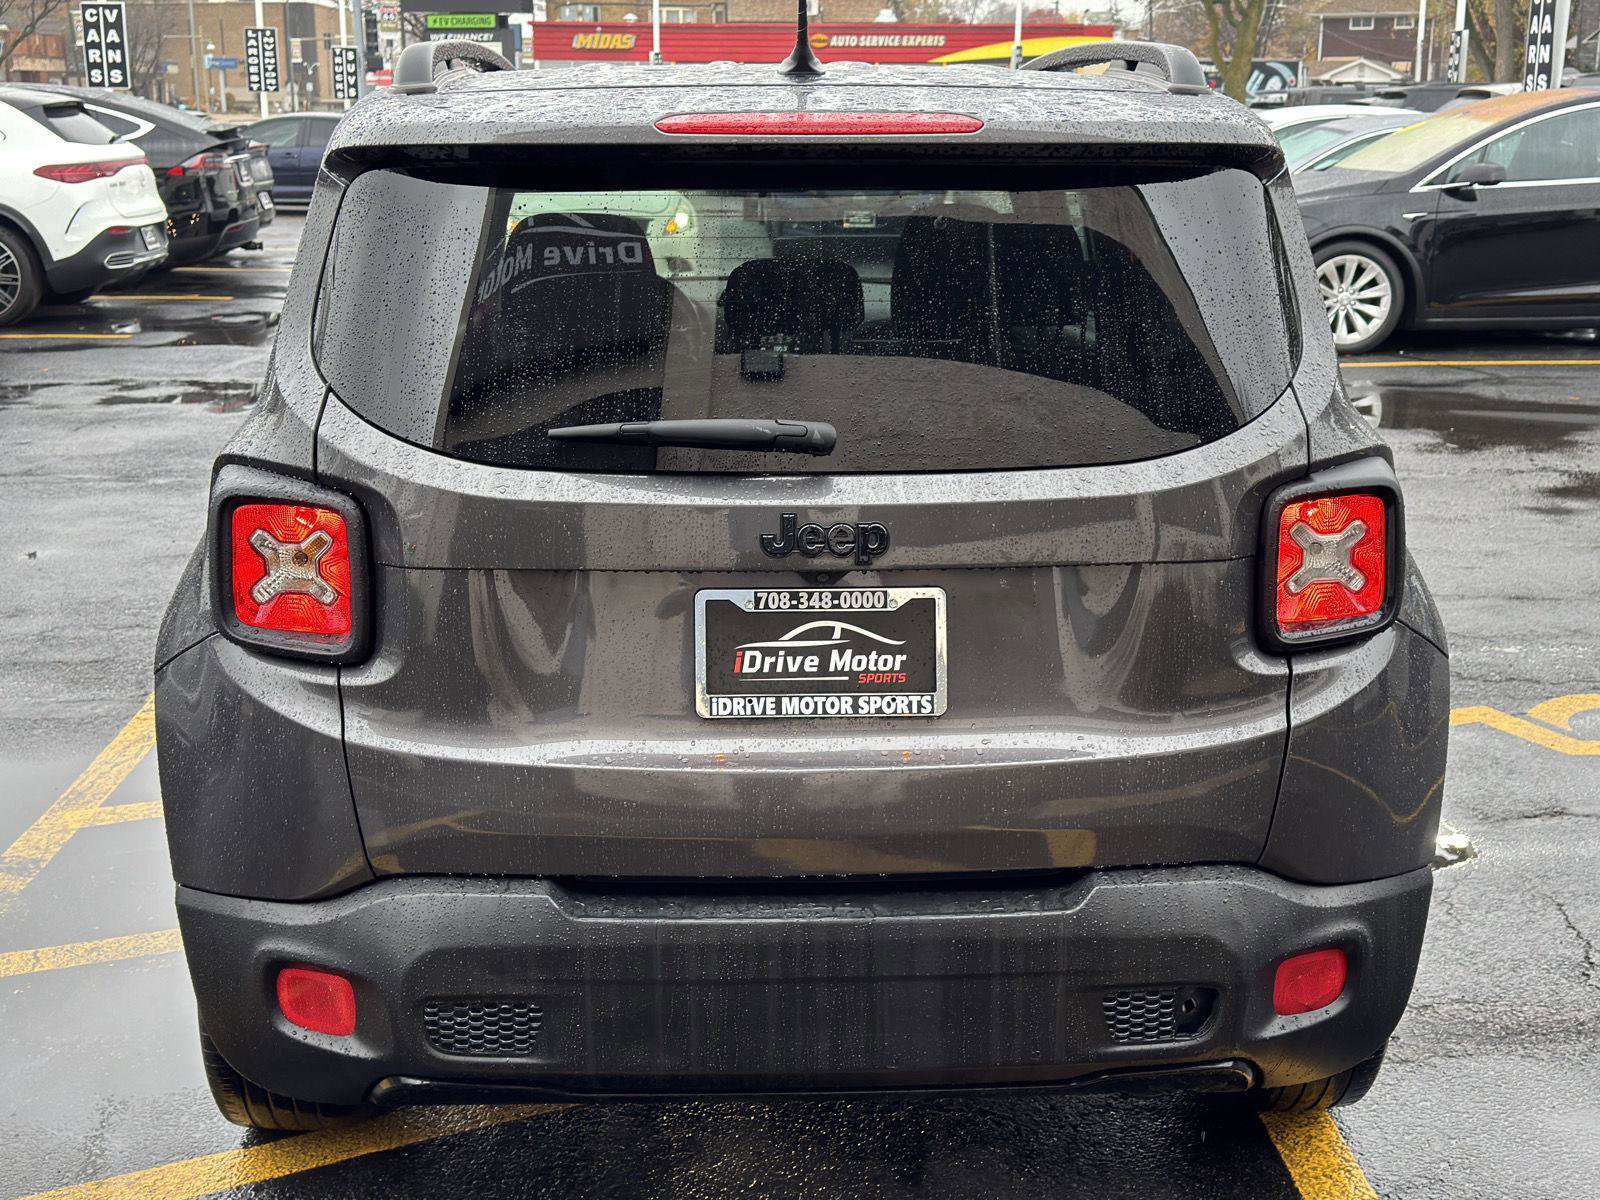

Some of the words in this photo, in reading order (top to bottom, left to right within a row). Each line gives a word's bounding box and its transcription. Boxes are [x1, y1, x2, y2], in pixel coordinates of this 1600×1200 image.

[84, 8, 103, 83] CARS
[103, 9, 124, 83] VANS
[576, 33, 632, 49] MIDAS
[830, 35, 858, 47] AUTO
[860, 35, 901, 47] SERVICE
[902, 35, 946, 47] EXPERTS
[1525, 0, 1541, 92] ARS
[1537, 0, 1552, 92] ANS
[760, 513, 890, 566] Jeep
[757, 592, 885, 609] 708-348-0000
[733, 650, 820, 674] iDrive
[829, 649, 907, 672] Motor
[858, 673, 907, 684] SPORTS
[781, 696, 853, 715] MOTOR
[858, 695, 932, 714] SPORTS
